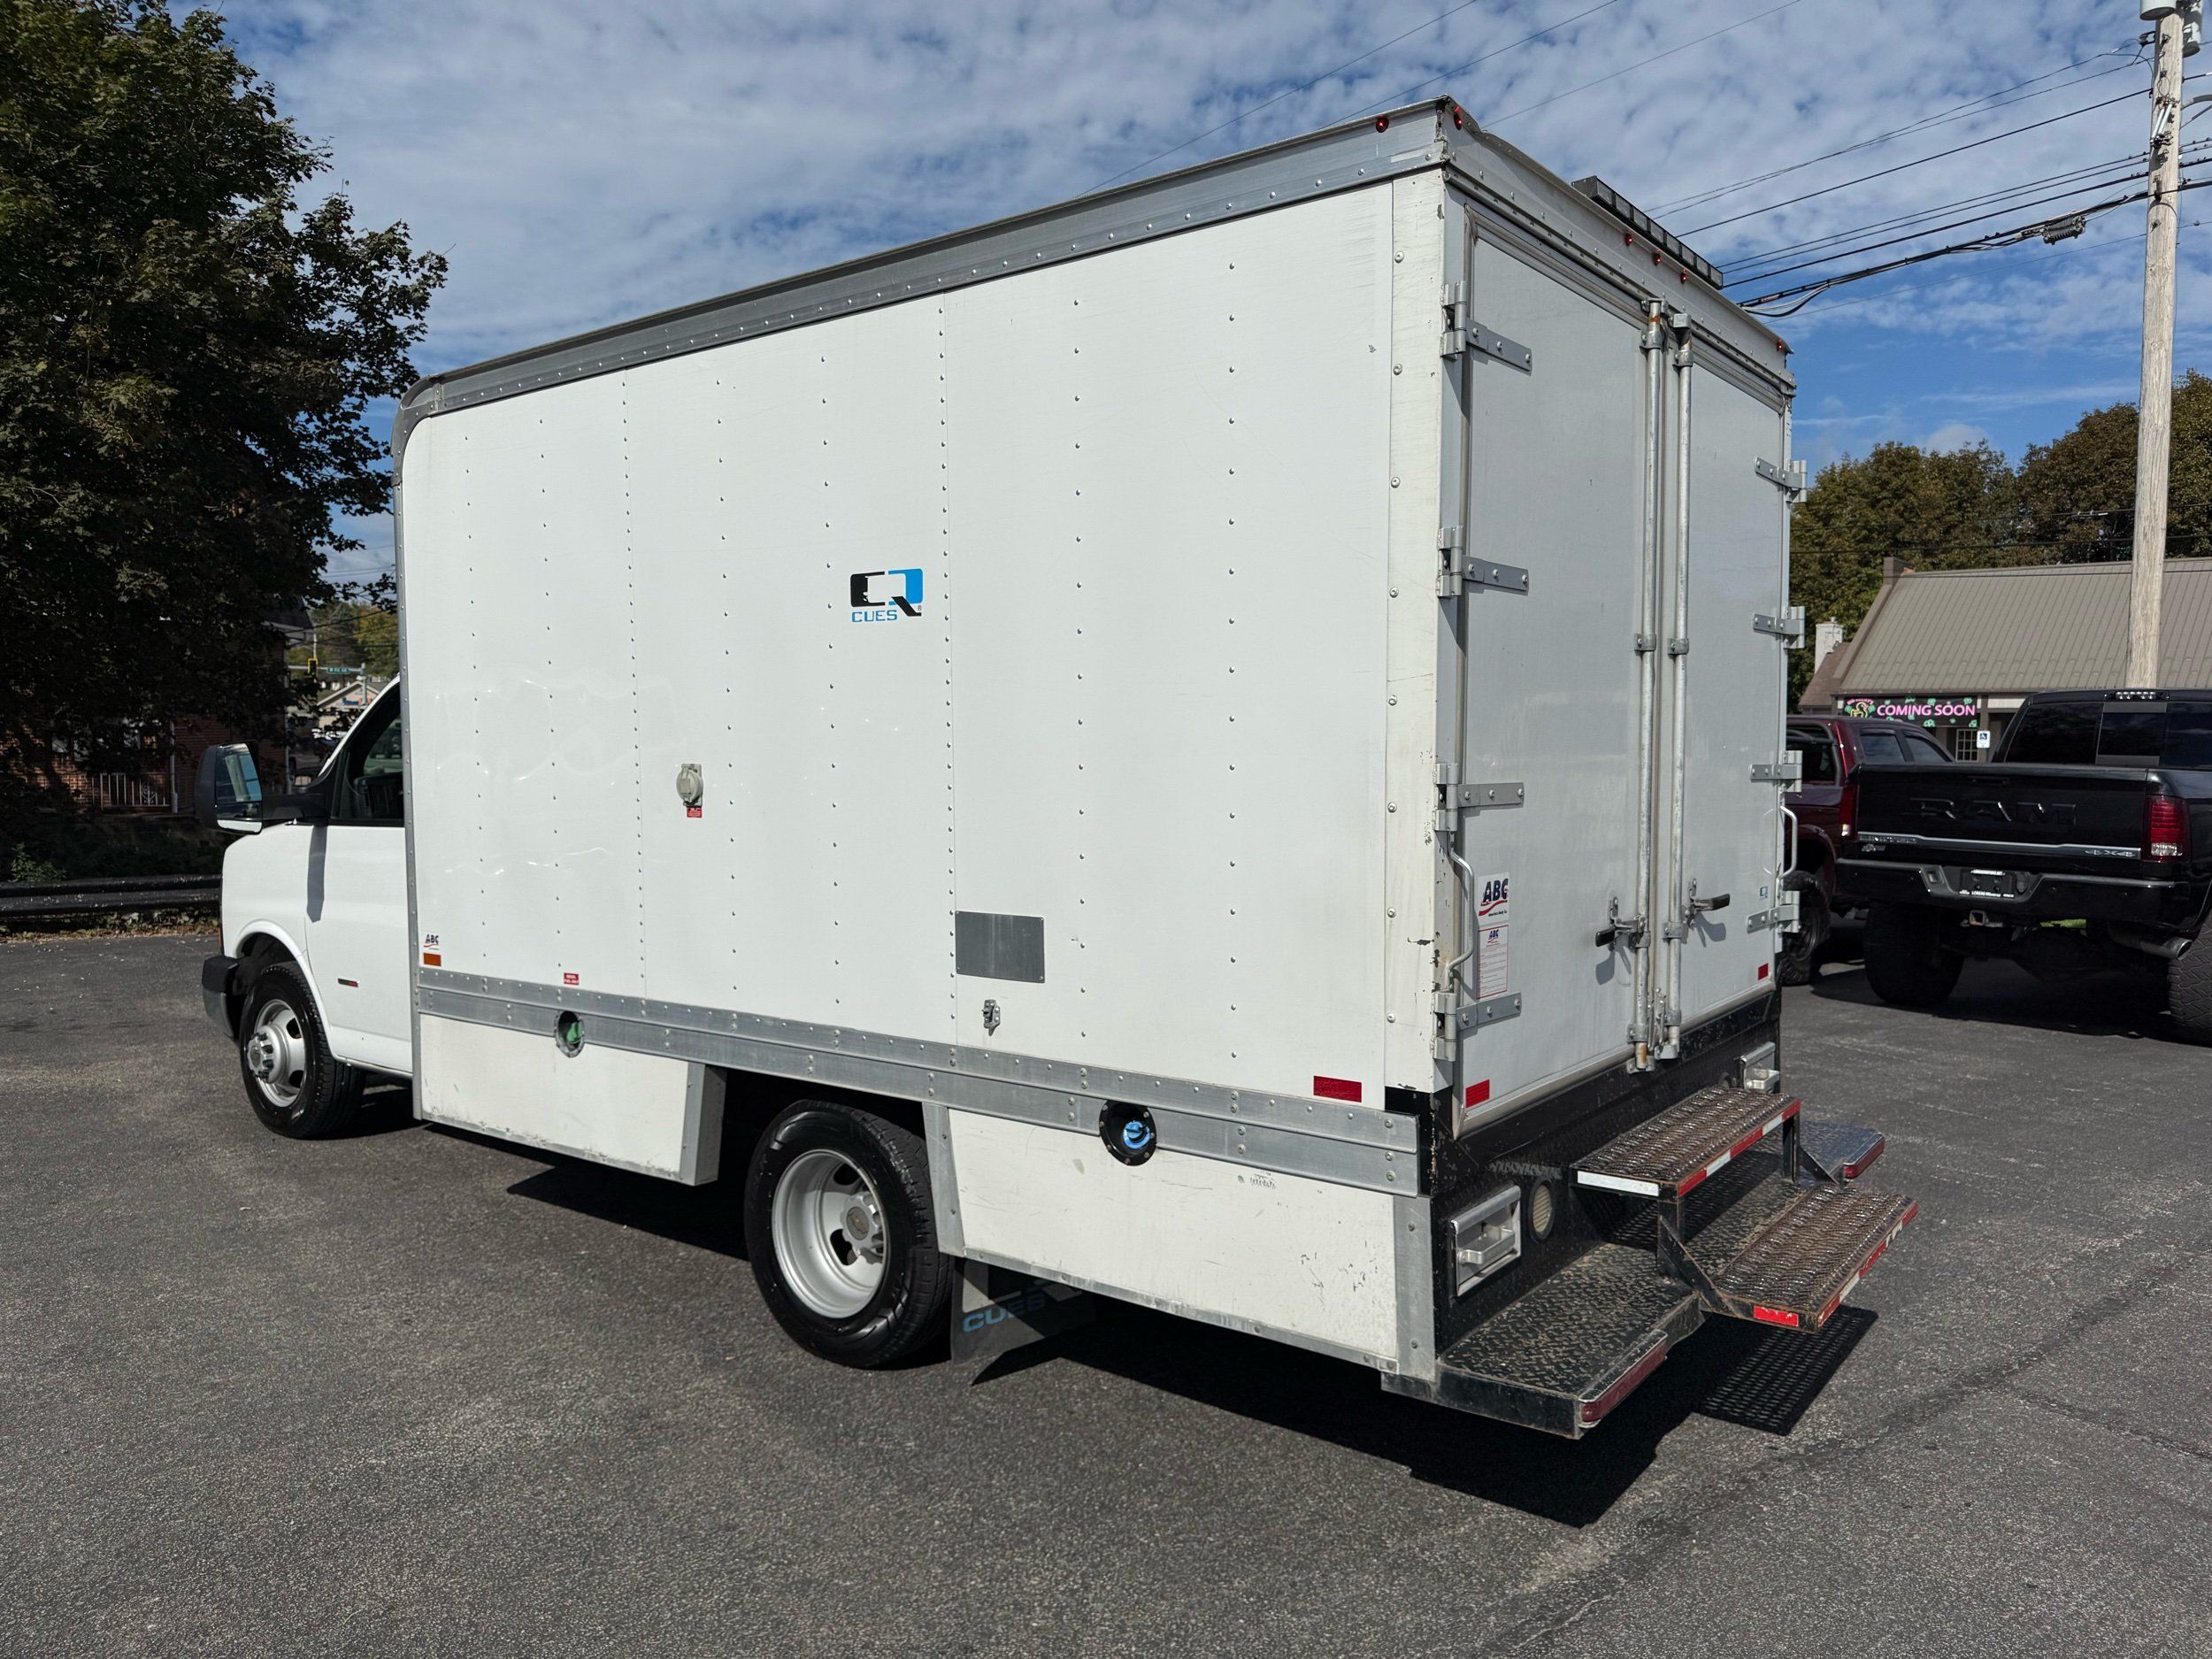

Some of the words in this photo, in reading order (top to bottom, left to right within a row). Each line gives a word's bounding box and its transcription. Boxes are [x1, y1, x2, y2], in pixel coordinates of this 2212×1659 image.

[851, 609, 898, 623] CUES
[1877, 703, 1931, 717] COMING
[1934, 703, 1976, 717] SOON
[1909, 797, 2077, 826] RAM
[1482, 878, 1509, 902] ABC
[425, 933, 440, 944] ABC
[1488, 929, 1500, 940] ABC
